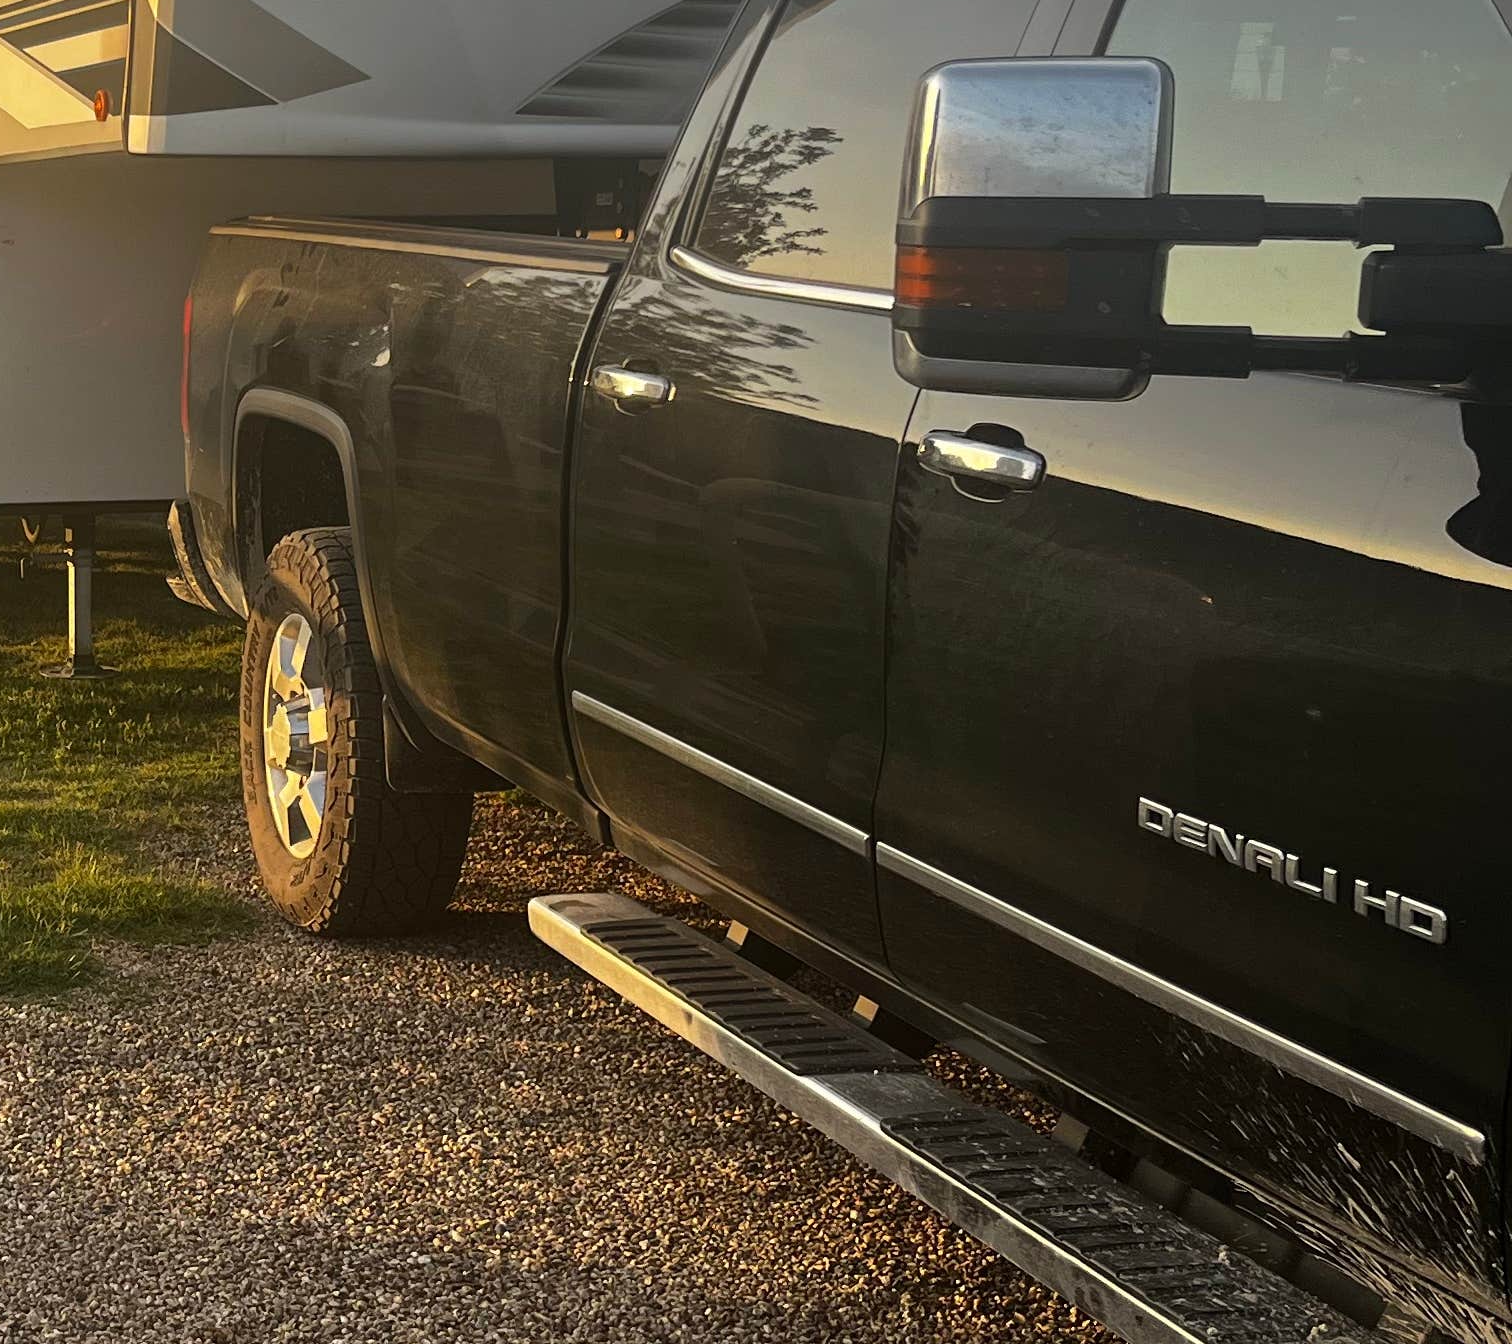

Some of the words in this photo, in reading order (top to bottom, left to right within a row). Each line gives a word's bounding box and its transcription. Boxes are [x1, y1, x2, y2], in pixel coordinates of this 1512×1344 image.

[242, 619, 260, 728] COUNTRY
[1137, 796, 1338, 905] DENALI
[1353, 878, 1448, 946] HD
